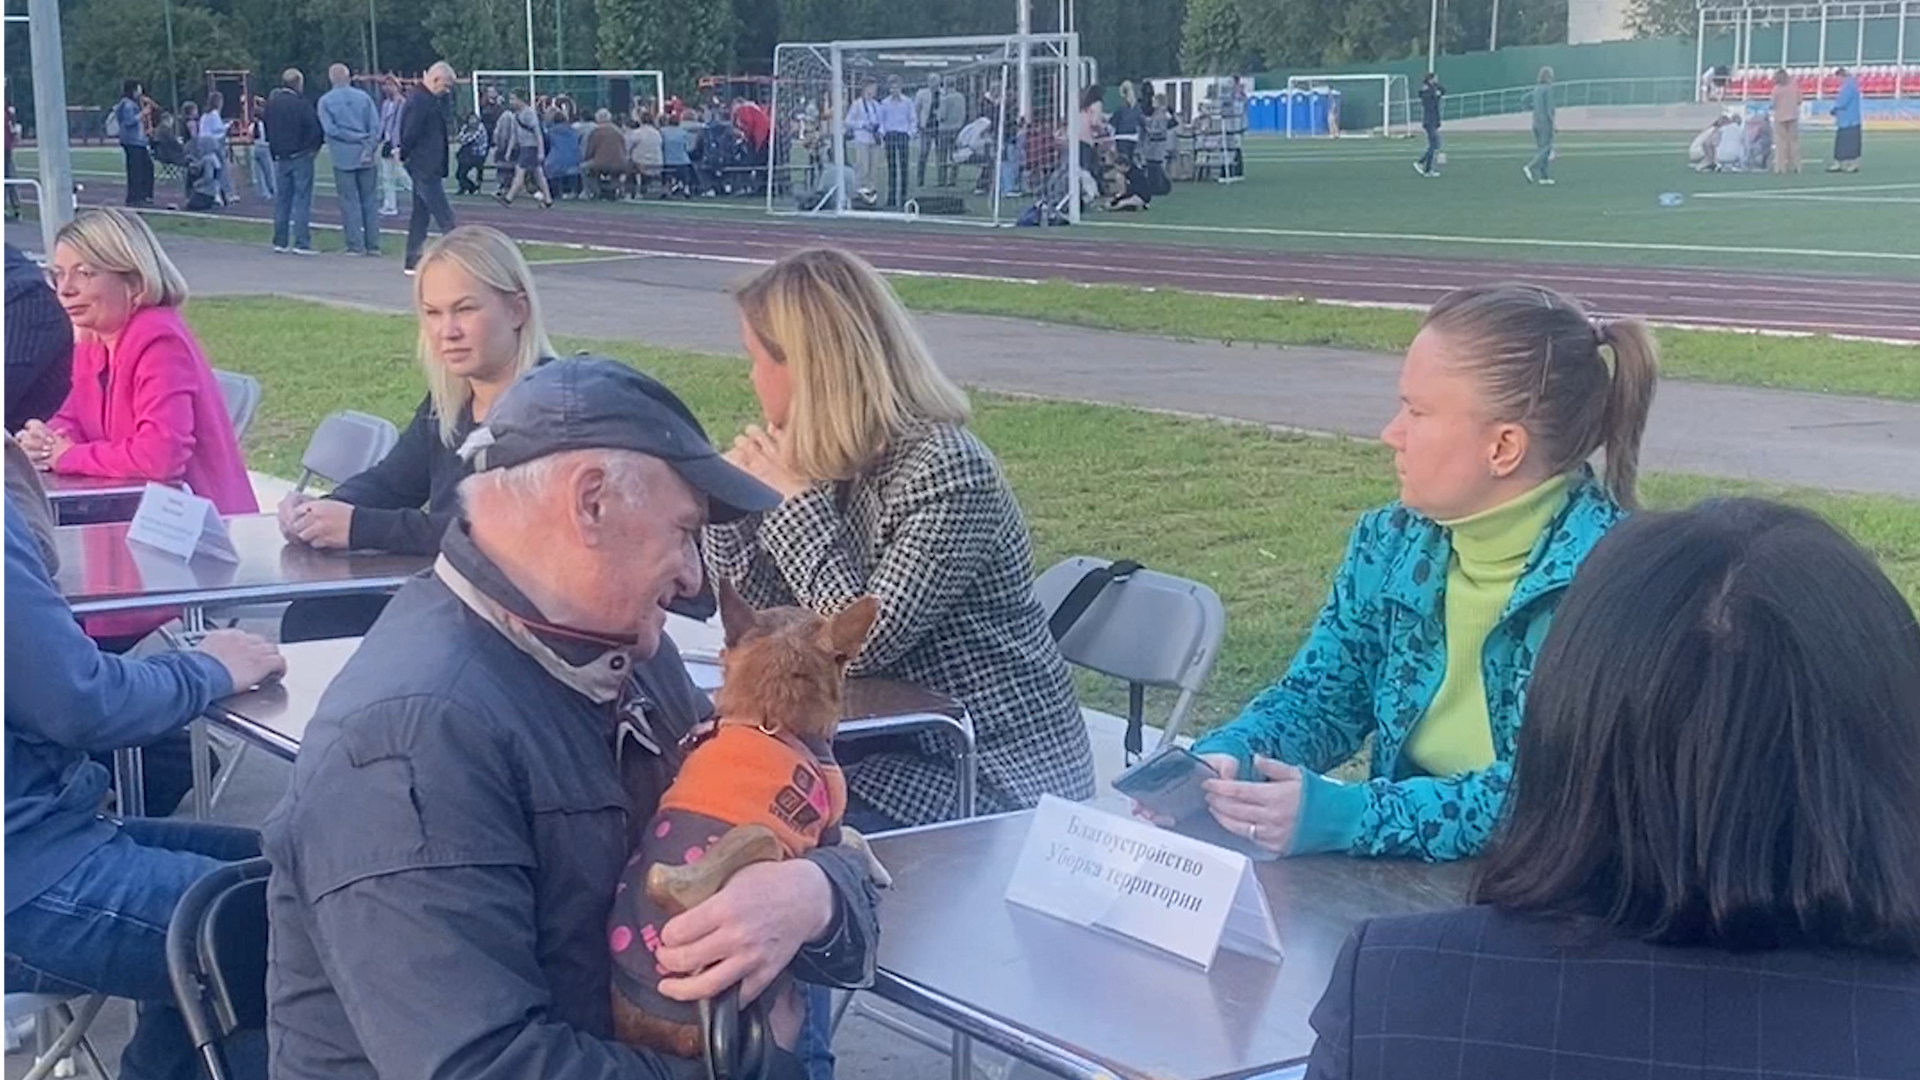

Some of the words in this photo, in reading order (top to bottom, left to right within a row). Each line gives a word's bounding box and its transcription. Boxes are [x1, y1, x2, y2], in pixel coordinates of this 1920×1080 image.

[1046, 842, 1102, 878] Уборка
[1105, 869, 1203, 912] территории
[1066, 815, 1203, 877] Благоустройство
